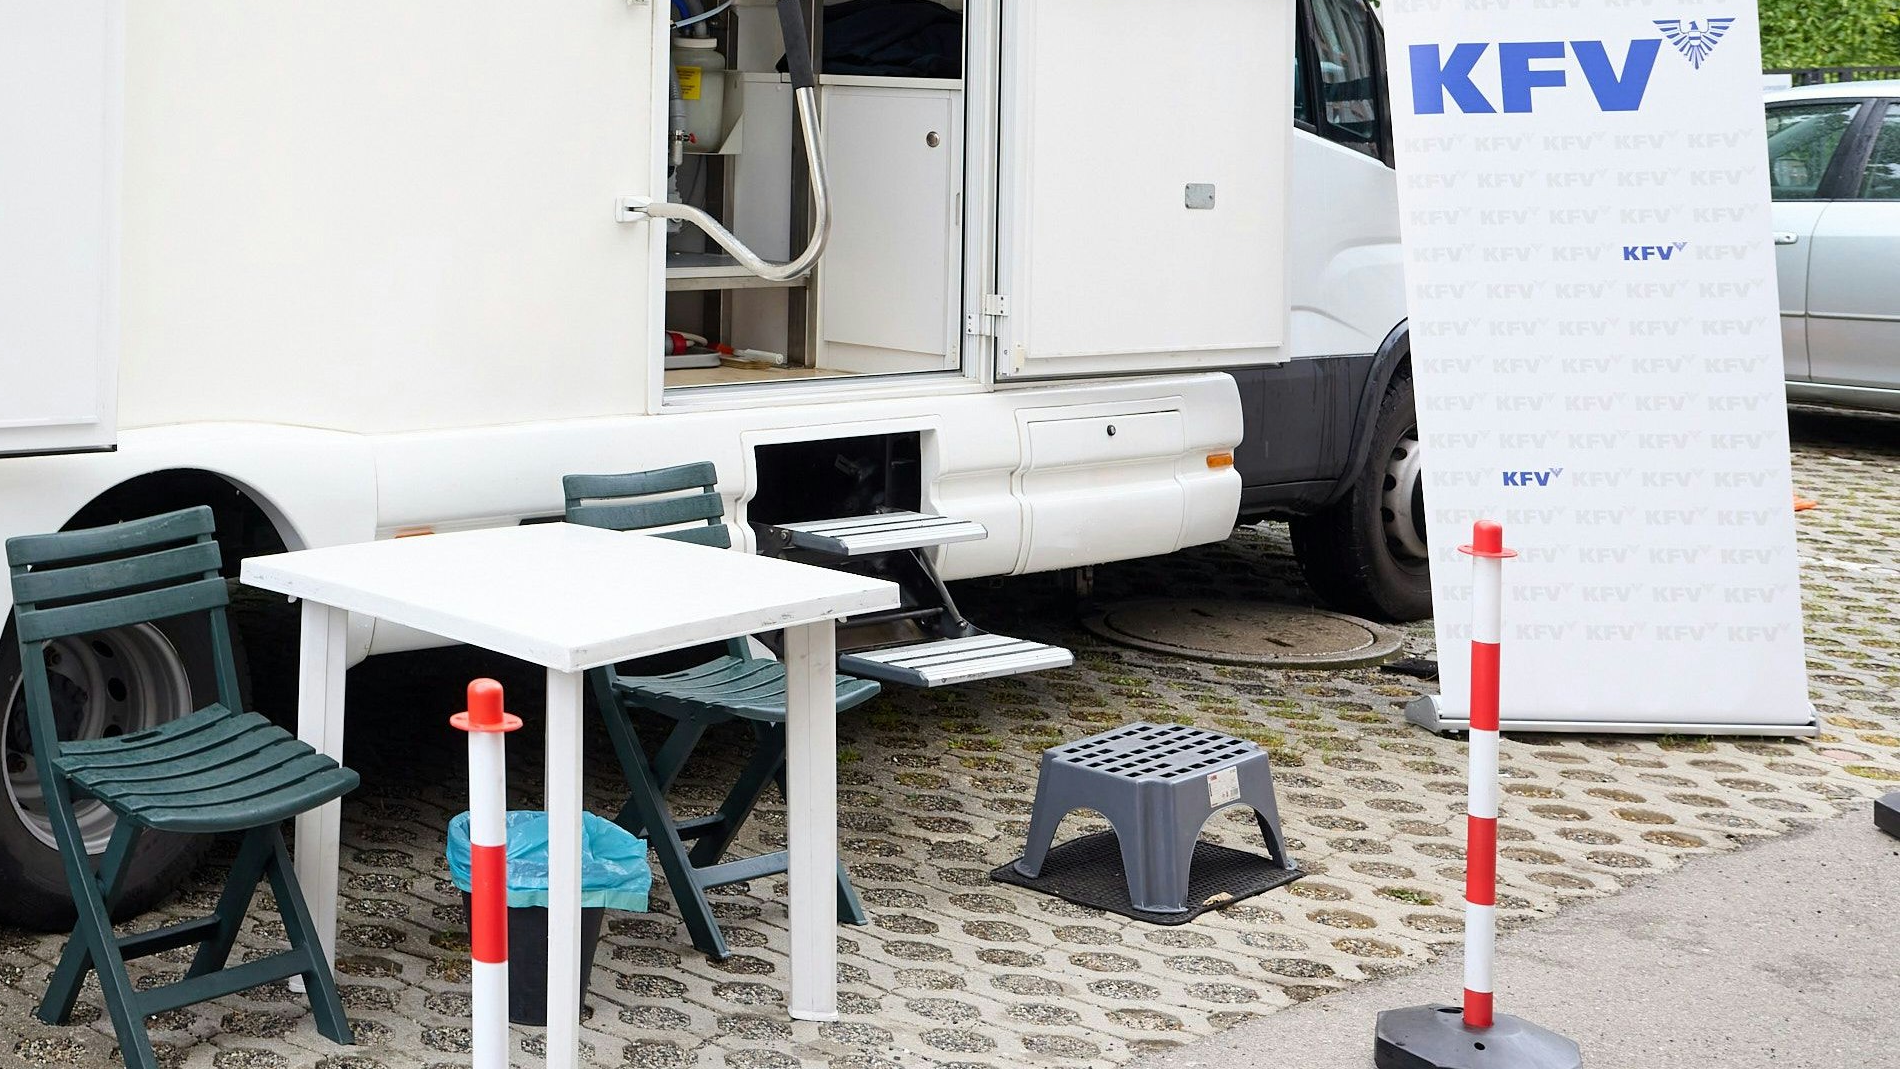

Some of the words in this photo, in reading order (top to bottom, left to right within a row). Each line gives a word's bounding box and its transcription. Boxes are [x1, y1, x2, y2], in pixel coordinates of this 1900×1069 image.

[1409, 39, 1662, 114] KFV
[1405, 137, 1453, 152] KFV
[1474, 136, 1523, 151] KFV
[1544, 135, 1593, 150] KFV
[1614, 134, 1664, 149] KFV
[1687, 133, 1738, 148] KFV
[1408, 174, 1456, 189] KFV
[1477, 173, 1526, 188] KFV
[1547, 172, 1596, 187] KFV
[1617, 171, 1667, 186] KFV
[1690, 170, 1740, 186] KFV
[1411, 210, 1459, 225] KFV
[1480, 209, 1529, 225] KFV
[1550, 209, 1599, 224] KFV
[1620, 208, 1670, 224] KFV
[1693, 208, 1743, 223] KFV
[1414, 247, 1462, 262] KFV
[1483, 246, 1532, 262] KFV
[1552, 246, 1602, 261] KFV
[1623, 246, 1673, 261] KFV
[1696, 245, 1746, 260] KFV
[1417, 284, 1465, 299] KFV
[1486, 283, 1535, 299] KFV
[1556, 283, 1605, 298] KFV
[1626, 283, 1676, 298] KFV
[1699, 283, 1749, 298] KFV
[1420, 321, 1468, 336] KFV
[1489, 321, 1538, 336] KFV
[1559, 321, 1608, 336] KFV
[1629, 321, 1679, 336] KFV
[1702, 320, 1752, 335] KFV
[1423, 358, 1472, 373] KFV
[1493, 358, 1542, 373] KFV
[1562, 358, 1611, 373] KFV
[1632, 358, 1682, 373] KFV
[1705, 358, 1755, 373] KFV
[1426, 395, 1475, 411] KFV
[1496, 396, 1545, 411] KFV
[1565, 396, 1614, 411] KFV
[1635, 396, 1685, 411] KFV
[1708, 396, 1758, 411] KFV
[1430, 433, 1478, 448] KFV
[1499, 433, 1548, 448] KFV
[1568, 434, 1618, 449] KFV
[1638, 434, 1688, 449] KFV
[1711, 434, 1761, 449] KFV
[1433, 471, 1482, 486] KFV
[1502, 471, 1552, 486] KFV
[1572, 472, 1621, 487] KFV
[1642, 472, 1692, 487] KFV
[1714, 472, 1765, 487] KFV
[1506, 509, 1555, 525] KFV
[1575, 510, 1625, 525] KFV
[1645, 510, 1695, 525] KFV
[1718, 510, 1768, 526] KFV
[1579, 548, 1628, 564] KFV
[1649, 549, 1699, 564] KFV
[1721, 549, 1771, 564] KFV
[1513, 586, 1562, 601] KFV
[1582, 587, 1632, 602] KFV
[1652, 587, 1702, 603] KFV
[1725, 587, 1775, 603] KFV
[1516, 625, 1566, 640] KFV
[1586, 626, 1635, 641] KFV
[1656, 626, 1706, 641] KFV
[1728, 626, 1779, 642] KFV
